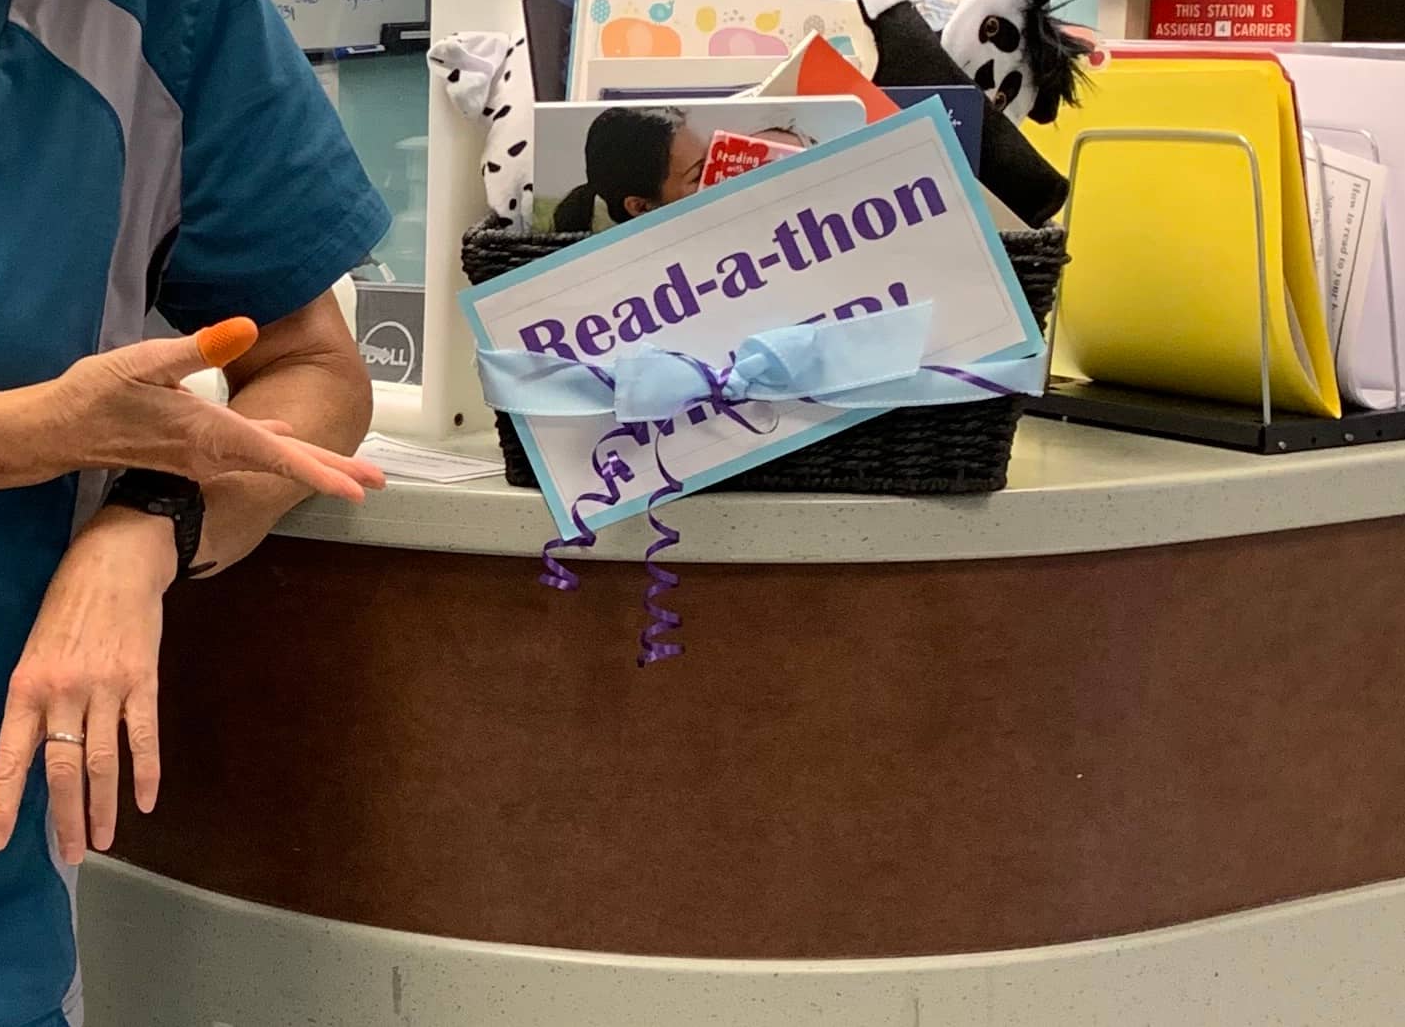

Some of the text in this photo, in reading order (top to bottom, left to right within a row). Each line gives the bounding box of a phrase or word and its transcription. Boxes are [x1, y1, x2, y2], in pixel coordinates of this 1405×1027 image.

[1175, 3, 1274, 18] THIS STATION IS
[1155, 22, 1213, 36] ASSIGNED
[1232, 22, 1292, 37] CARRIERS
[716, 149, 760, 168] Reading
[1351, 183, 1362, 208] How
[1347, 212, 1355, 226] to
[1339, 227, 1351, 255] read
[519, 176, 948, 364] Read-a-thon
